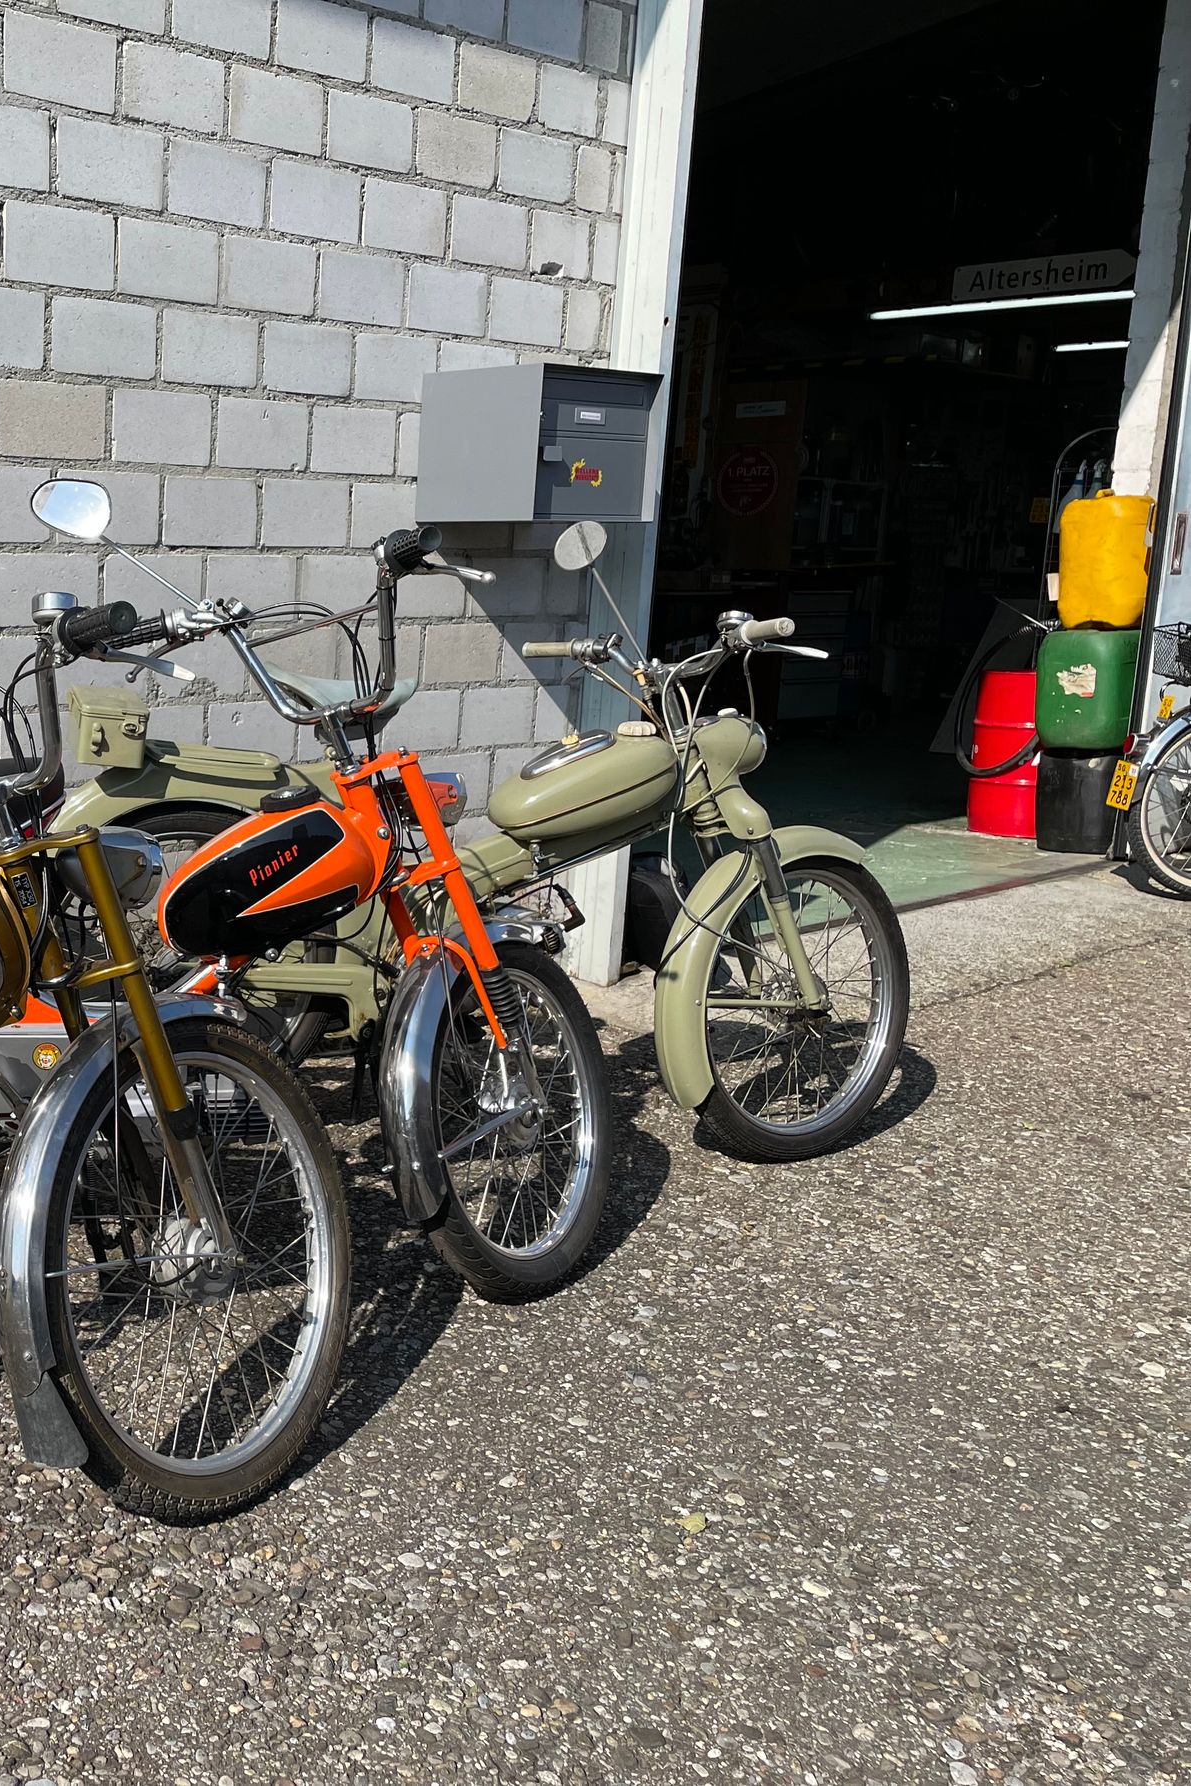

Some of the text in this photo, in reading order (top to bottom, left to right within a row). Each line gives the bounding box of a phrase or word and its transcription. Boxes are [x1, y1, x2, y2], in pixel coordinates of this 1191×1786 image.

[968, 258, 1108, 293] Altersheim
[736, 464, 771, 477] PLATZ
[1113, 774, 1133, 790] 213
[1109, 789, 1129, 806] 788
[249, 844, 299, 887] Pionier
